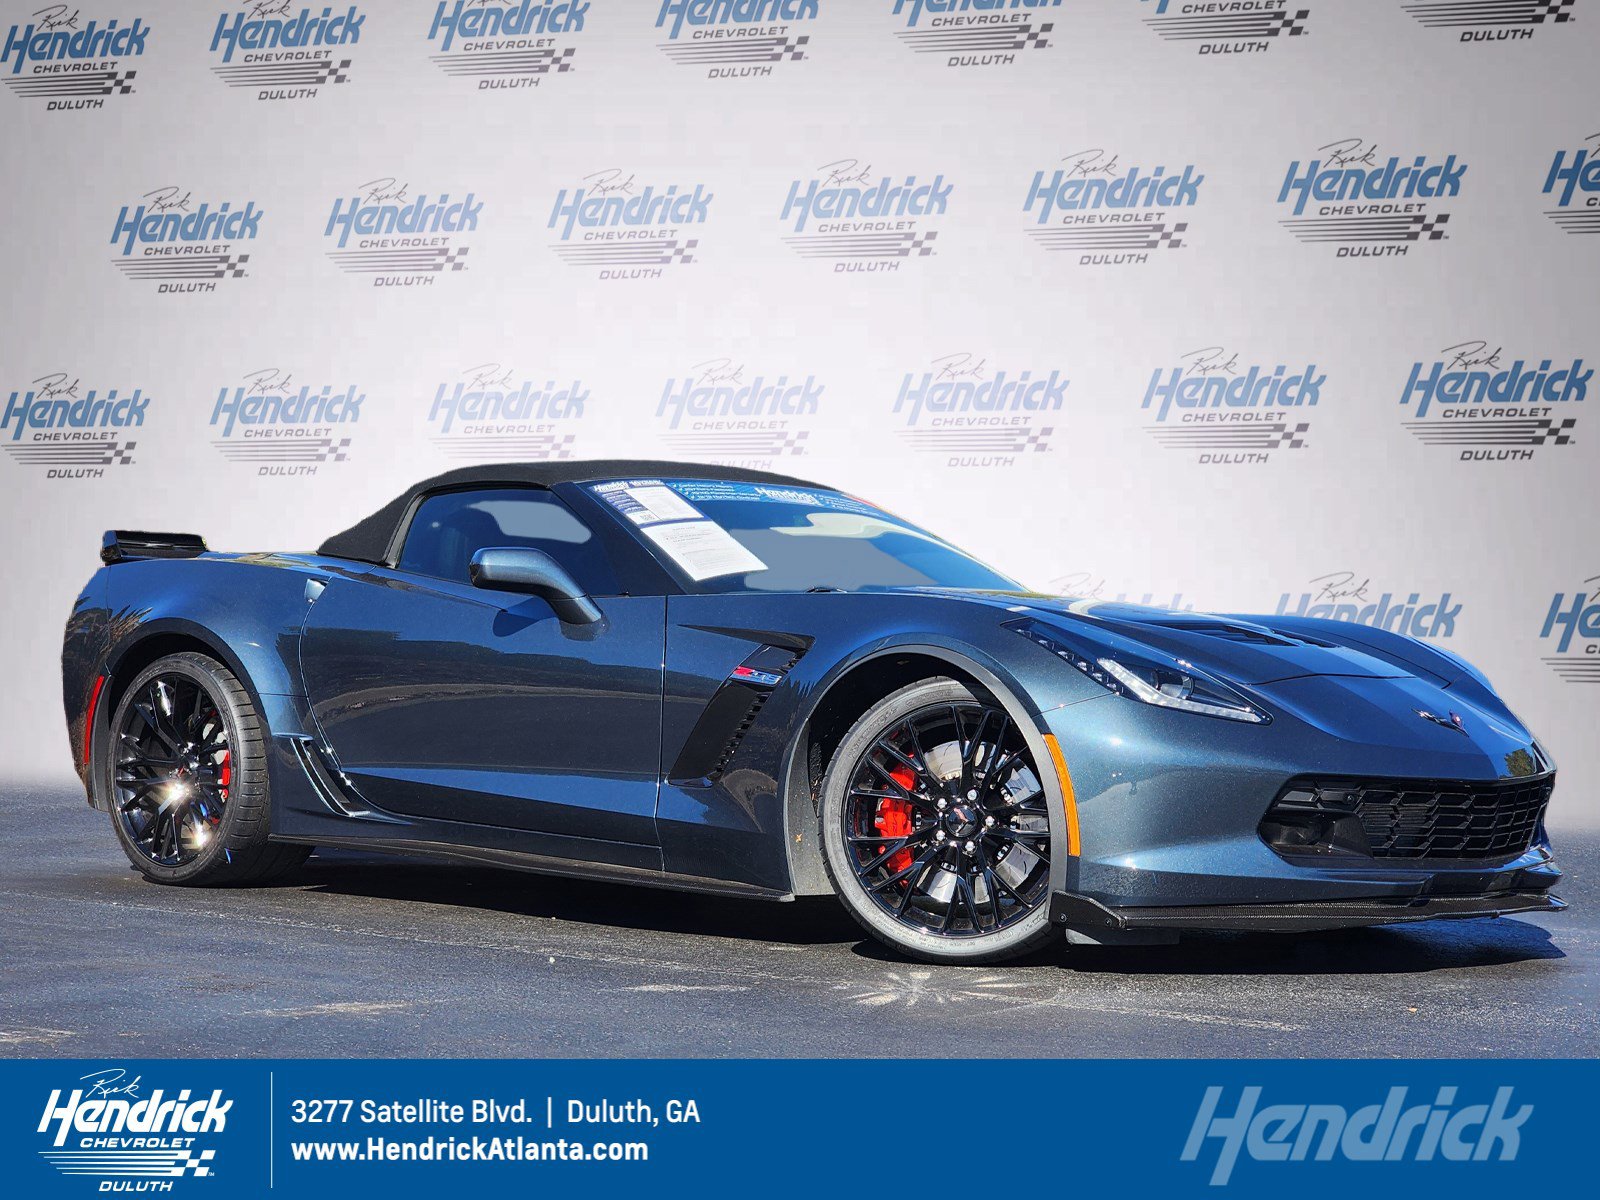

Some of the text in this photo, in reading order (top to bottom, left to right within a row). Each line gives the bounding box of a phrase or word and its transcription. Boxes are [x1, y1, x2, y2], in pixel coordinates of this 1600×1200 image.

[1182, 0, 1286, 13] CHEVROLET
[428, 0, 590, 51] Hendrick
[932, 13, 1031, 26] CHEVROLET
[210, 6, 366, 63] Hendrick
[693, 26, 788, 39] CHEVROLET
[1460, 28, 1534, 42] DULUTH
[0, 18, 149, 75] Hendrick
[464, 39, 555, 51] CHEVROLET
[1199, 42, 1269, 54] DULUTH
[244, 50, 332, 62] CHEVROLET
[948, 54, 1015, 66] DULUTH
[33, 62, 117, 73] CHEVROLET
[708, 66, 772, 78] DULUTH
[479, 78, 540, 89] DULUTH
[258, 89, 317, 100] DULUTH
[47, 99, 104, 110] DULUTH
[1278, 154, 1467, 215] Hendrick
[1024, 165, 1204, 224] Hendrick
[781, 175, 953, 232] Hendrick
[1320, 203, 1426, 215] CHEVROLET
[548, 184, 712, 240] Hendrick
[325, 193, 484, 248] Hendrick
[1063, 213, 1165, 224] CHEVROLET
[111, 202, 263, 256] Hendrick
[818, 221, 916, 232] CHEVROLET
[584, 229, 678, 240] CHEVROLET
[360, 238, 449, 248] CHEVROLET
[144, 245, 230, 255] CHEVROLET
[1337, 245, 1408, 257] DULUTH
[1080, 253, 1148, 265] DULUTH
[834, 261, 900, 272] DULUTH
[599, 269, 662, 279] DULUTH
[374, 276, 434, 287] DULUTH
[158, 283, 216, 293] DULUTH
[1143, 364, 1327, 421] Hendrick
[1400, 359, 1594, 417] Hendrick
[656, 374, 824, 428] Hendrick
[893, 370, 1070, 425] Hendrick
[210, 385, 365, 438] Hendrick
[427, 379, 589, 434] Hendrick
[0, 389, 149, 440] Hendrick
[1183, 412, 1286, 422] CHEVROLET
[1443, 408, 1552, 418] CHEVROLET
[693, 420, 788, 430] CHEVROLET
[932, 416, 1032, 426] CHEVROLET
[244, 428, 331, 438] CHEVROLET
[464, 425, 555, 434] CHEVROLET
[33, 432, 117, 441] CHEVROLET
[1199, 453, 1269, 464] DULUTH
[1460, 450, 1534, 460] DULUTH
[948, 457, 1015, 467] DULUTH
[47, 469, 103, 478] DULUTH
[258, 466, 317, 475] DULUTH
